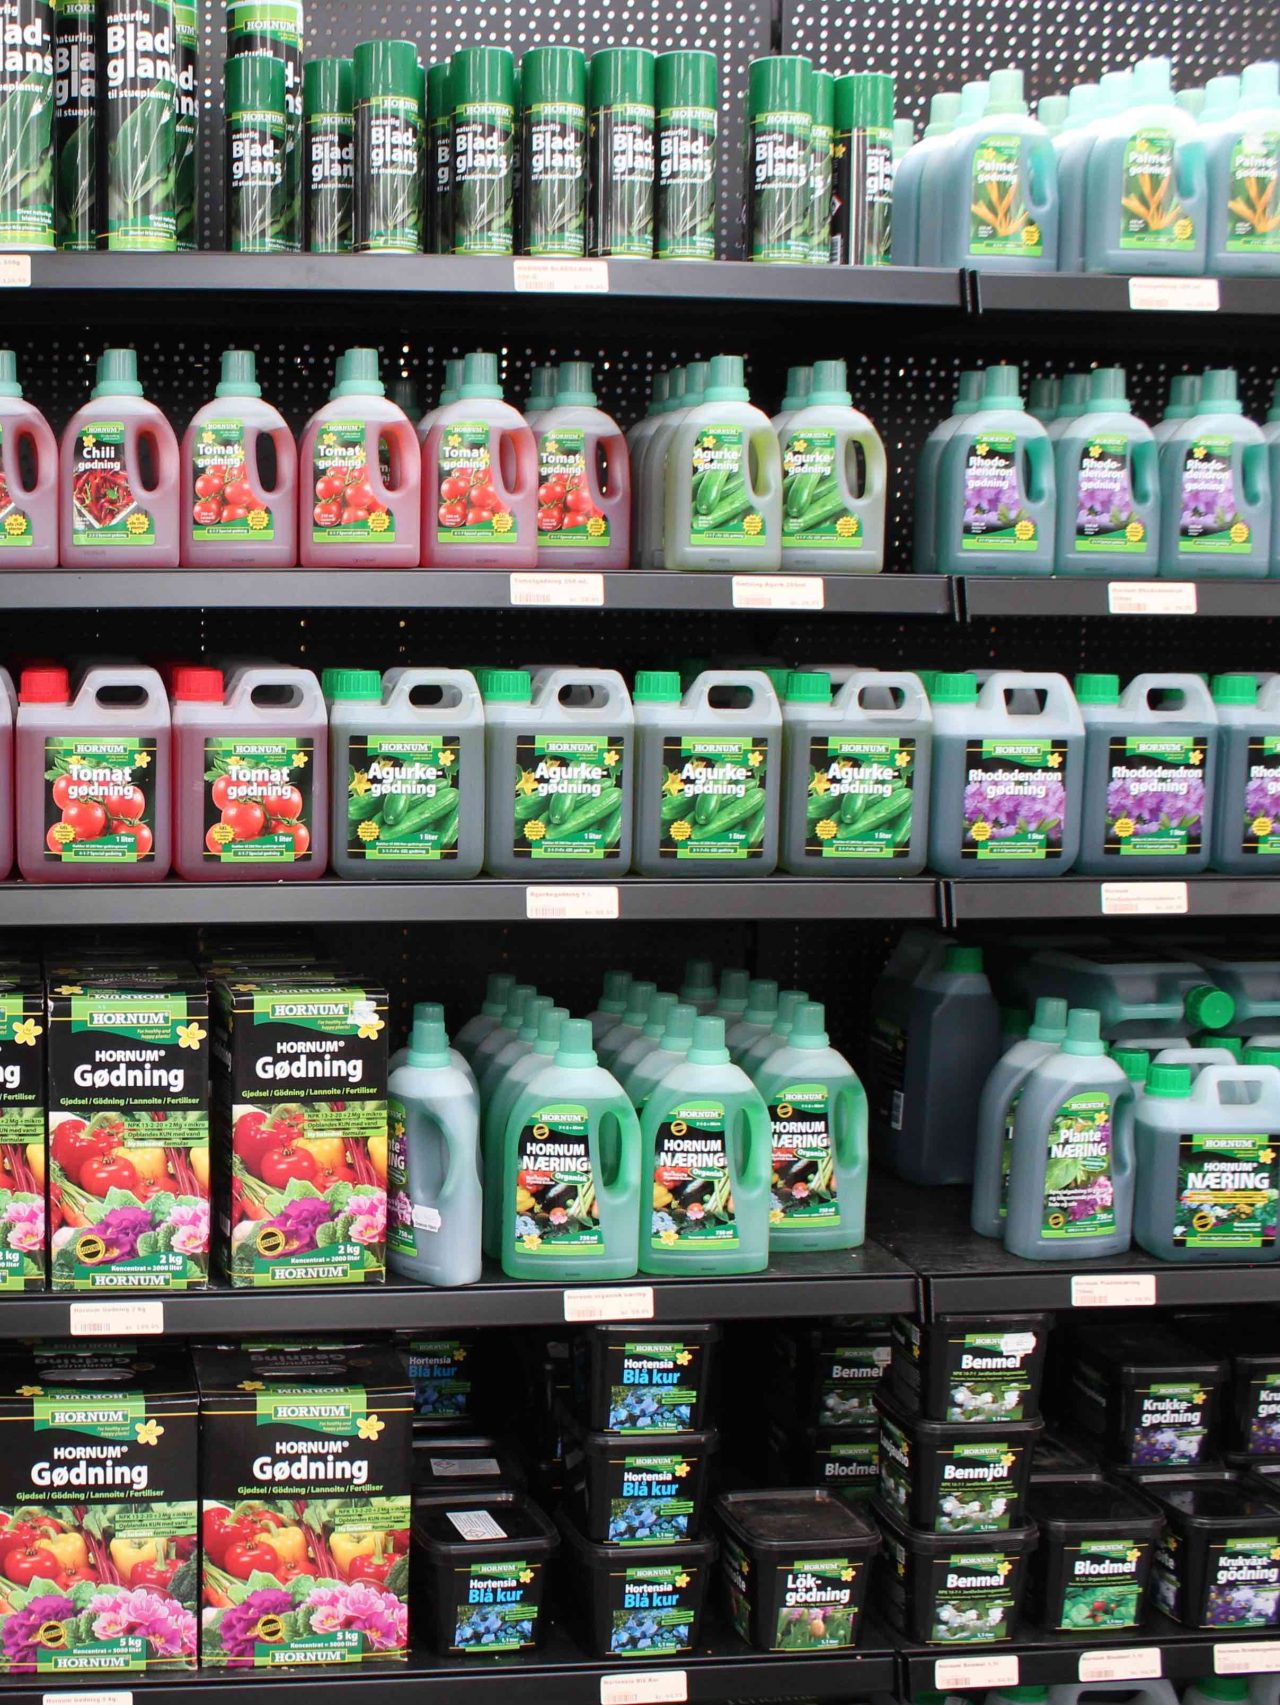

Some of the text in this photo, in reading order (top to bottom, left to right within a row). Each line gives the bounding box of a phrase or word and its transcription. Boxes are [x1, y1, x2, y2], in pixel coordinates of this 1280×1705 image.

[456, 134, 504, 152] Blad-
[660, 136, 709, 154] Blad-
[371, 145, 418, 167] glans
[1129, 152, 1172, 165] Palme-
[660, 156, 711, 178] glans
[977, 160, 1018, 172] Palme-
[83, 446, 115, 459] Chili
[694, 448, 740, 461] Agurke-
[786, 452, 834, 464] Agurke-
[969, 457, 1009, 468] Rhodo-
[969, 467, 1013, 477] dendron
[228, 765, 290, 782] Tomat
[368, 762, 442, 784] Agurke-
[534, 762, 607, 784] Agurke-
[681, 763, 752, 783] Agurke-
[968, 770, 1061, 782] Rhododendron
[1112, 767, 1202, 779] Rhododendron
[68, 782, 134, 799] gødning
[255, 1055, 363, 1082] Gødning
[74, 1064, 185, 1092] Gødning
[770, 1121, 825, 1134] HORNUM
[1061, 1129, 1101, 1142] Plante
[526, 1142, 585, 1156] HORNUM
[664, 1139, 722, 1153] HORNUM
[1051, 1143, 1107, 1158] NÆRING
[660, 1152, 724, 1169] NÆRING
[797, 1149, 828, 1159] Organisk
[522, 1155, 588, 1172] NÆRING
[555, 1173, 588, 1183] Organisk
[692, 1168, 724, 1179] Organisk
[1188, 1173, 1269, 1189] NÆRING
[339, 1245, 343, 1254] 2
[623, 1358, 673, 1371] Hortensia
[962, 1354, 1021, 1369] Benmel
[623, 1368, 680, 1384] Blå kur
[832, 1365, 883, 1378] Benmel
[1143, 1399, 1190, 1411] Krukke-
[31, 1462, 149, 1489] Gødning
[623, 1471, 672, 1482] Hortensia
[944, 1465, 1008, 1480] Benmjöl
[238, 1483, 383, 1495] Gjødsel Gödning Lannoite Fertiliser
[623, 1481, 678, 1496] Blå kur
[1074, 1560, 1136, 1574] Blodmel
[1219, 1555, 1270, 1567] Krukväxt-
[947, 1573, 1004, 1587] Benmel
[1217, 1567, 1278, 1582] gödning
[469, 1578, 517, 1589] Hortensia
[625, 1583, 673, 1594] Hortensia
[787, 1575, 821, 1589] Lök-
[469, 1587, 523, 1603] Blå kur
[624, 1593, 679, 1608] Blå kur
[785, 1588, 850, 1607] gödning
